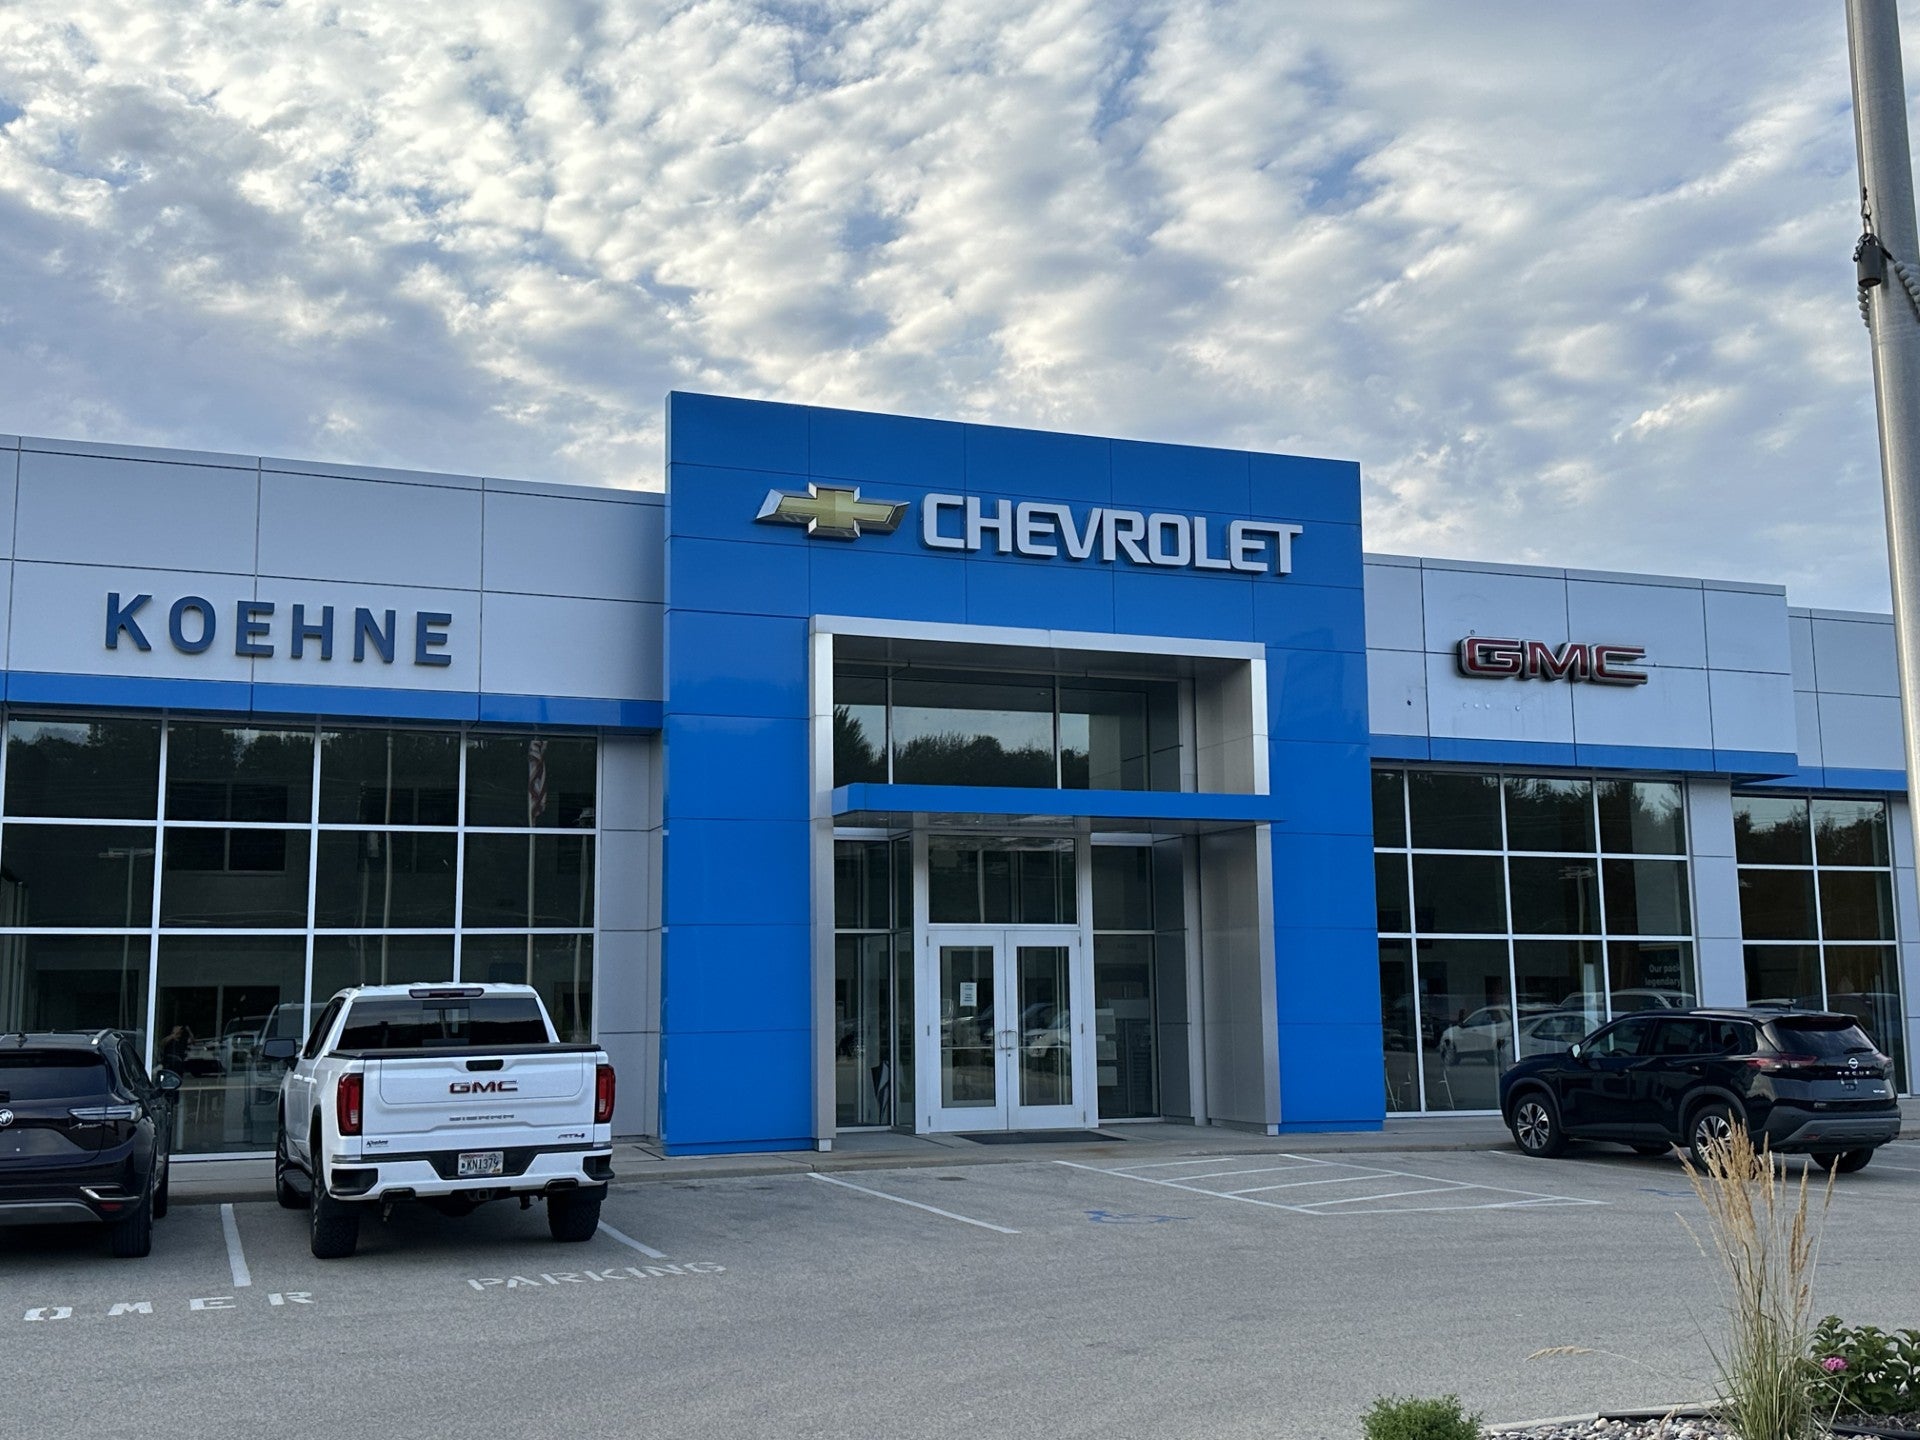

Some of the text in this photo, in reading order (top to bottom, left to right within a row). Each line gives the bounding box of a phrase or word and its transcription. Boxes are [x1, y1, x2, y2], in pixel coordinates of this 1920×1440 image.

[921, 492, 1303, 575] CHEVROLET
[105, 592, 452, 667] KOEHNE
[1456, 635, 1648, 687] GMC
[450, 1080, 518, 1094] GMC
[467, 1261, 727, 1290] PARKING
